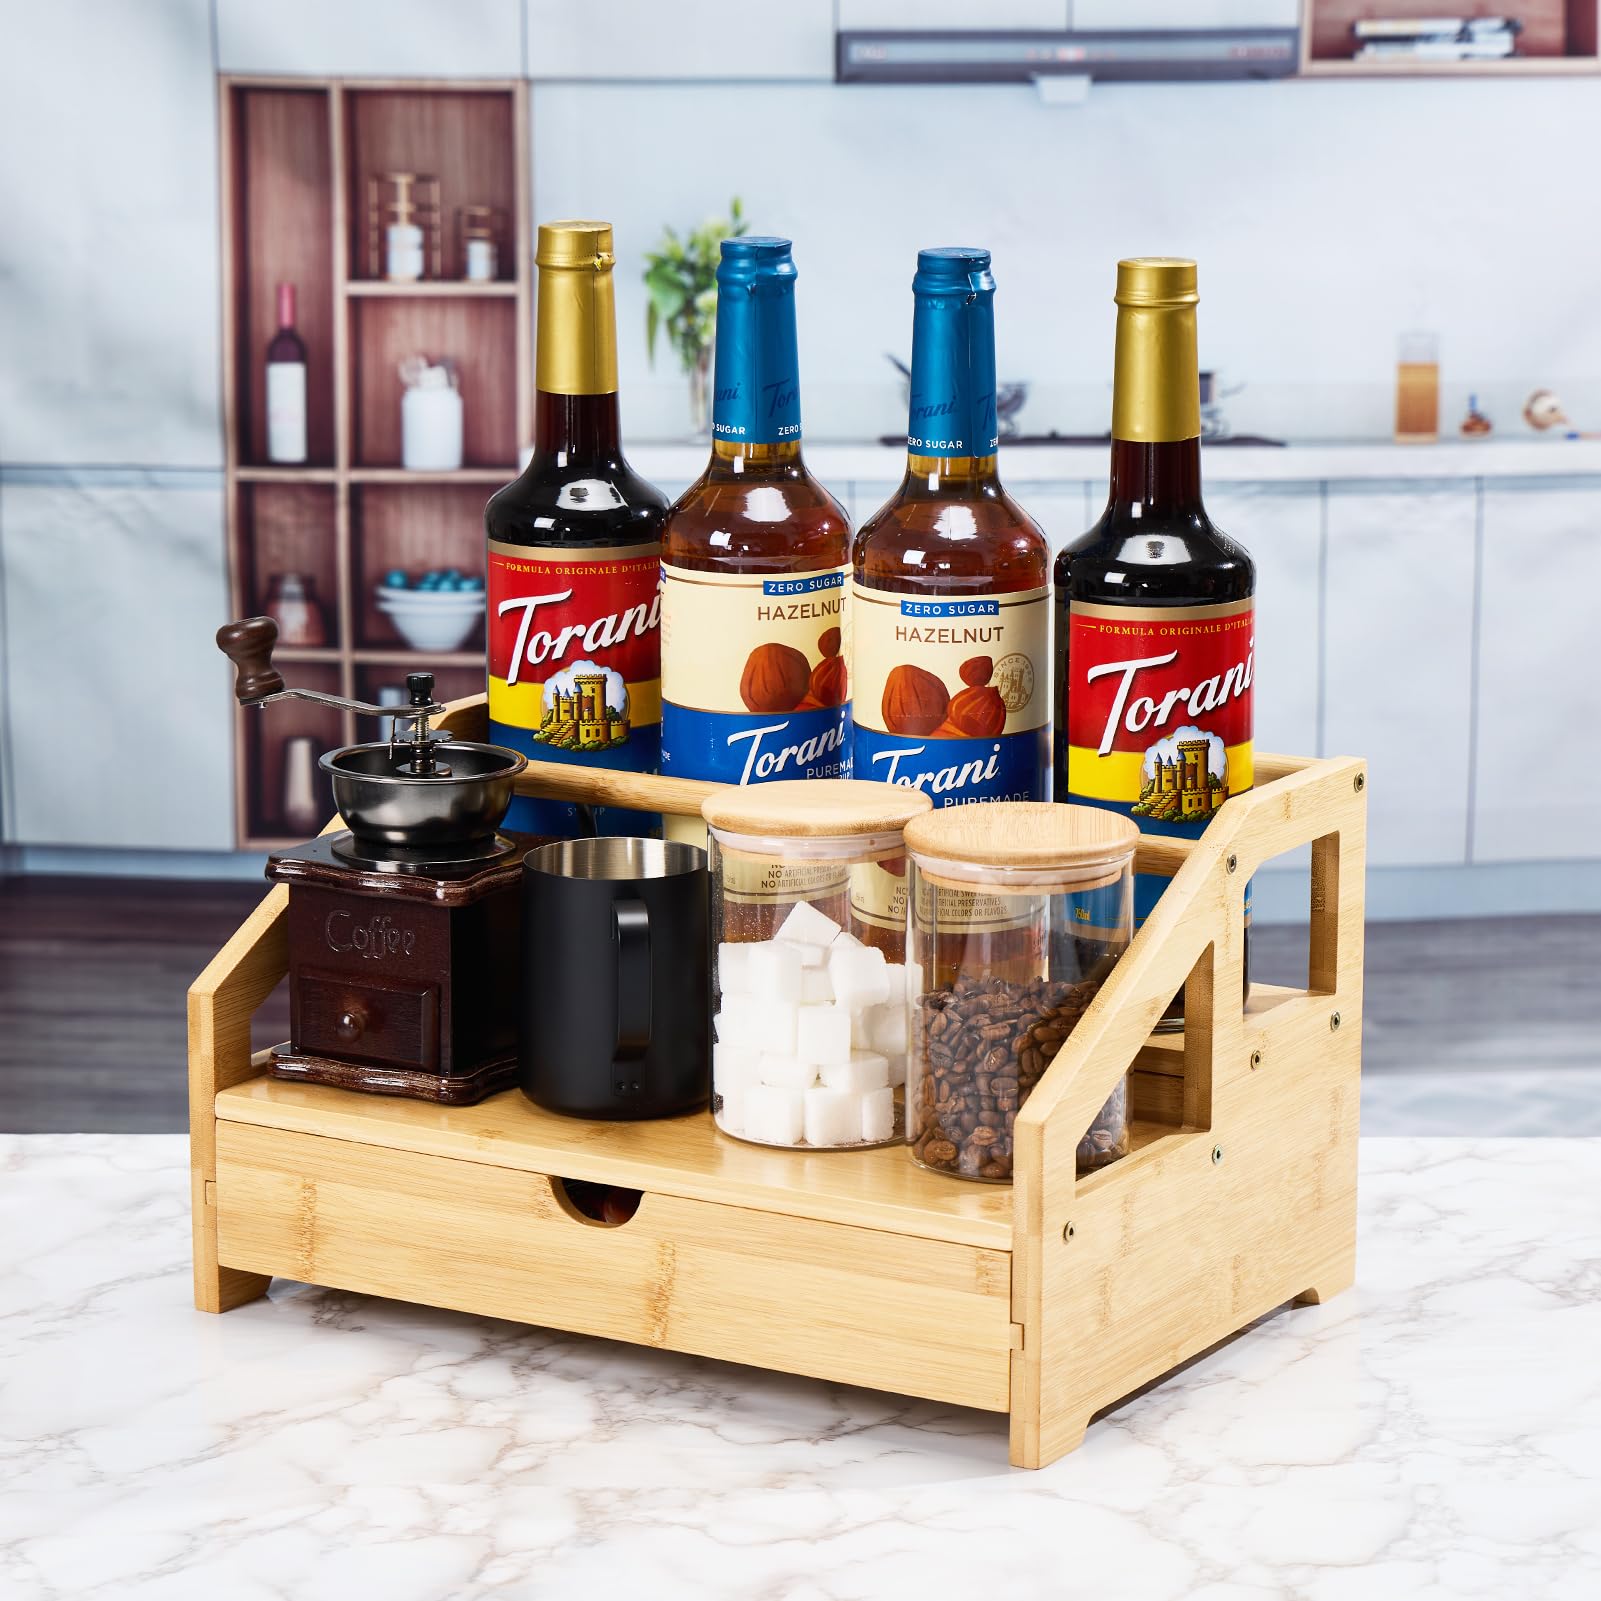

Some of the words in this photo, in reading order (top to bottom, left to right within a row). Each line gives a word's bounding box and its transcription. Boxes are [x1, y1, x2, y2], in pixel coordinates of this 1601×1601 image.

[762, 378, 799, 417] Tor
[716, 423, 746, 435] SUGAR
[778, 424, 799, 436] ZERO
[925, 440, 963, 449] SUGAR
[506, 562, 551, 574] FORMULA
[555, 566, 617, 575] ORIGINALE
[769, 582, 804, 593] ZERO
[809, 575, 843, 590] SUGAR
[757, 597, 847, 621] HAZELNUT
[905, 603, 942, 615] ZERO
[948, 604, 995, 614] SUGAR
[498, 584, 661, 686] Torani
[895, 625, 1005, 644] HAZELNUT
[1099, 625, 1154, 636] FORMULA
[1160, 624, 1221, 635] ORIGINALE
[1087, 636, 1254, 757] Torani
[727, 710, 846, 786] Torani
[872, 743, 1001, 795] Torani
[768, 870, 783, 879] NO
[761, 880, 776, 889] NO
[325, 909, 416, 960] Coffee
